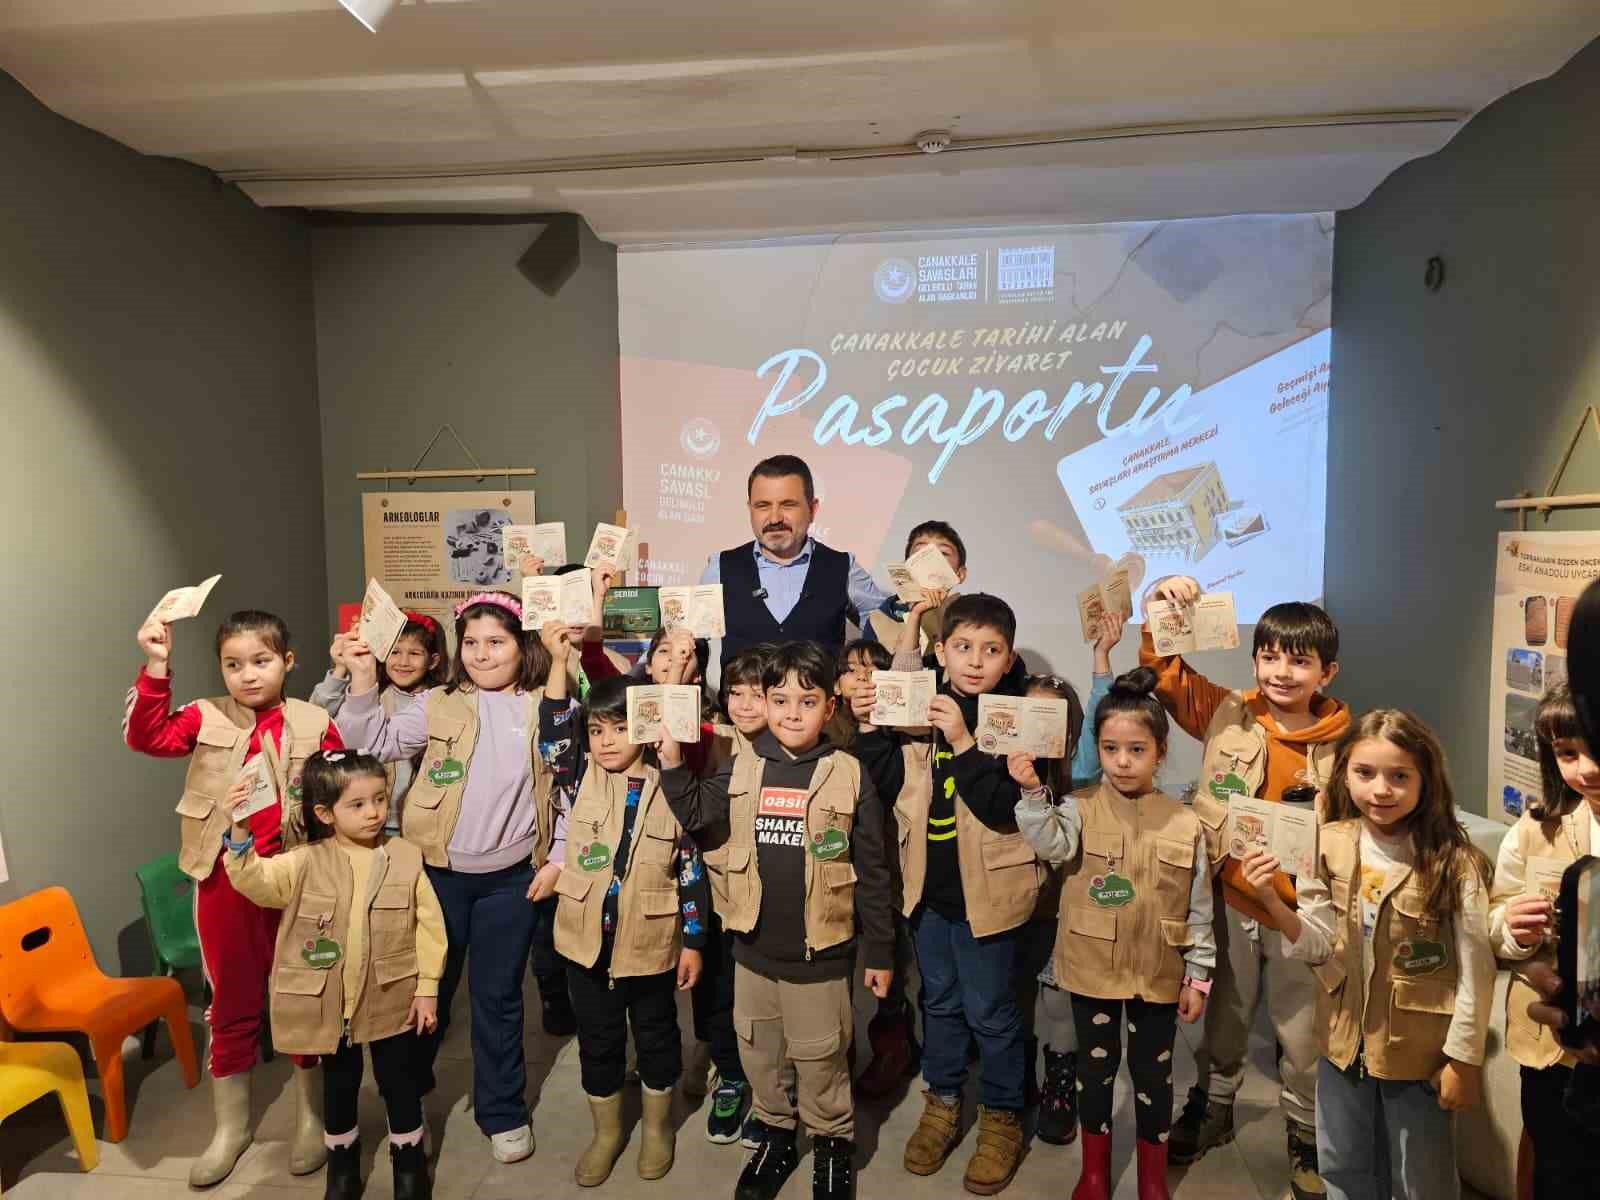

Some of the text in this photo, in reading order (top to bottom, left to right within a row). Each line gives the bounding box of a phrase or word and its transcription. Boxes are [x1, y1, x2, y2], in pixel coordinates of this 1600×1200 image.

[830, 319, 1129, 355] ÇANAKKALE TARİHİ ALAN
[886, 349, 1073, 382] ÇOCUK ZİYARET
[746, 334, 1203, 486] Pasaportu
[383, 511, 440, 523] ARKEOLOGLAR
